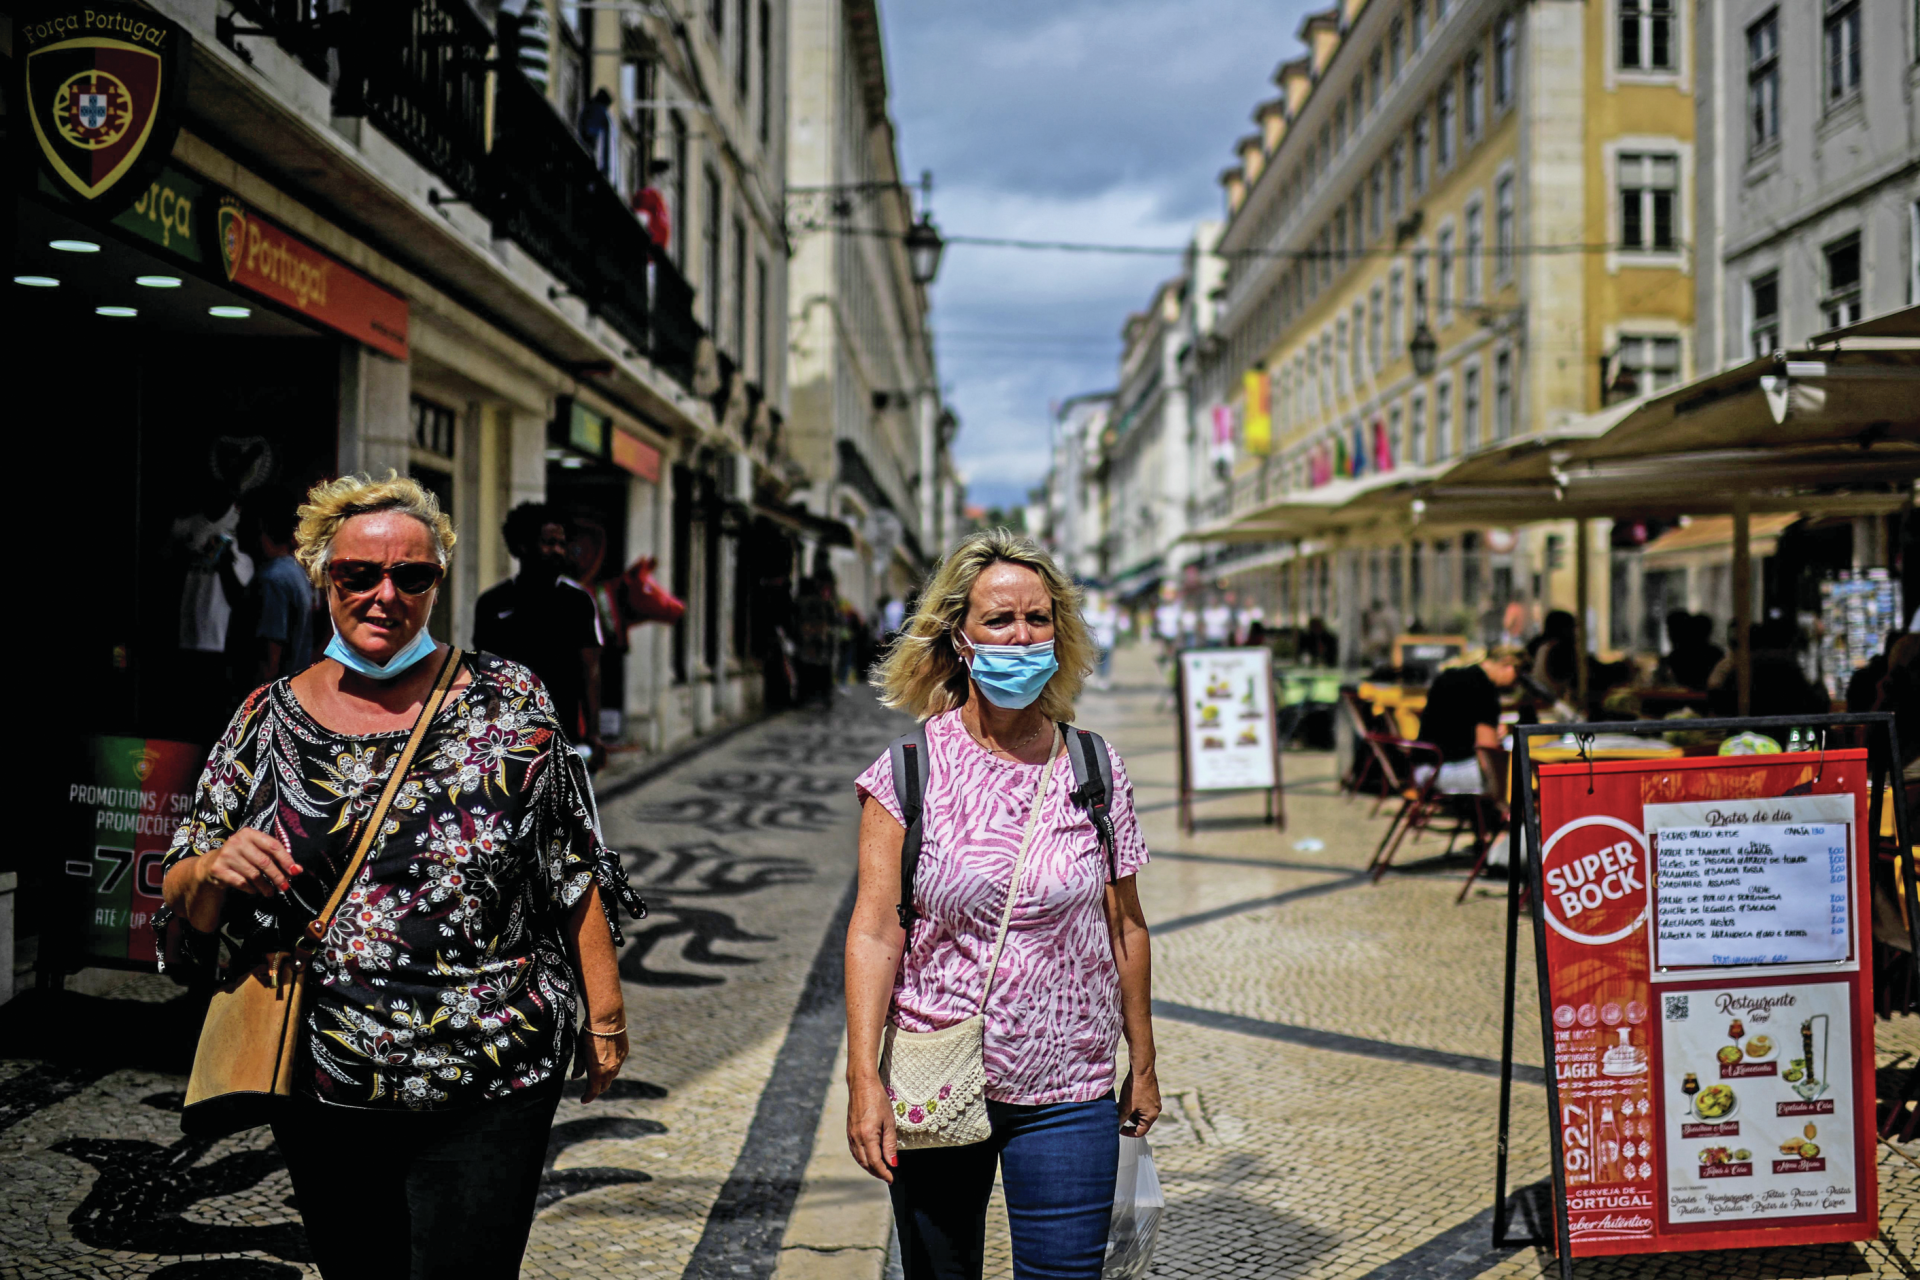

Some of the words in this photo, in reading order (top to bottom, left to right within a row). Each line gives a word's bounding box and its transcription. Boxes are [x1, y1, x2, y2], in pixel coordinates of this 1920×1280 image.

[22, 14, 79, 45] Força
[84, 9, 167, 47] Portugal
[246, 222, 333, 310] Portugal
[69, 783, 156, 812] PROMOTIONS
[96, 810, 180, 837] PROMOÇÕES
[1705, 809, 1749, 827] Pratos
[1752, 810, 1769, 822] do
[1772, 809, 1793, 822] dia
[1546, 841, 1639, 896] SUPER
[1559, 865, 1644, 919] BOCK
[94, 908, 118, 926] ATÉ
[129, 911, 147, 929] UP
[1715, 992, 1797, 1016] Restaurante
[1553, 1029, 1571, 1042] THE
[1555, 1062, 1598, 1080] LAGER
[1562, 1102, 1591, 1186] 1927
[1575, 1188, 1621, 1198] CERVEJA
[1622, 1186, 1636, 1195] DE
[1567, 1215, 1597, 1232] abor
